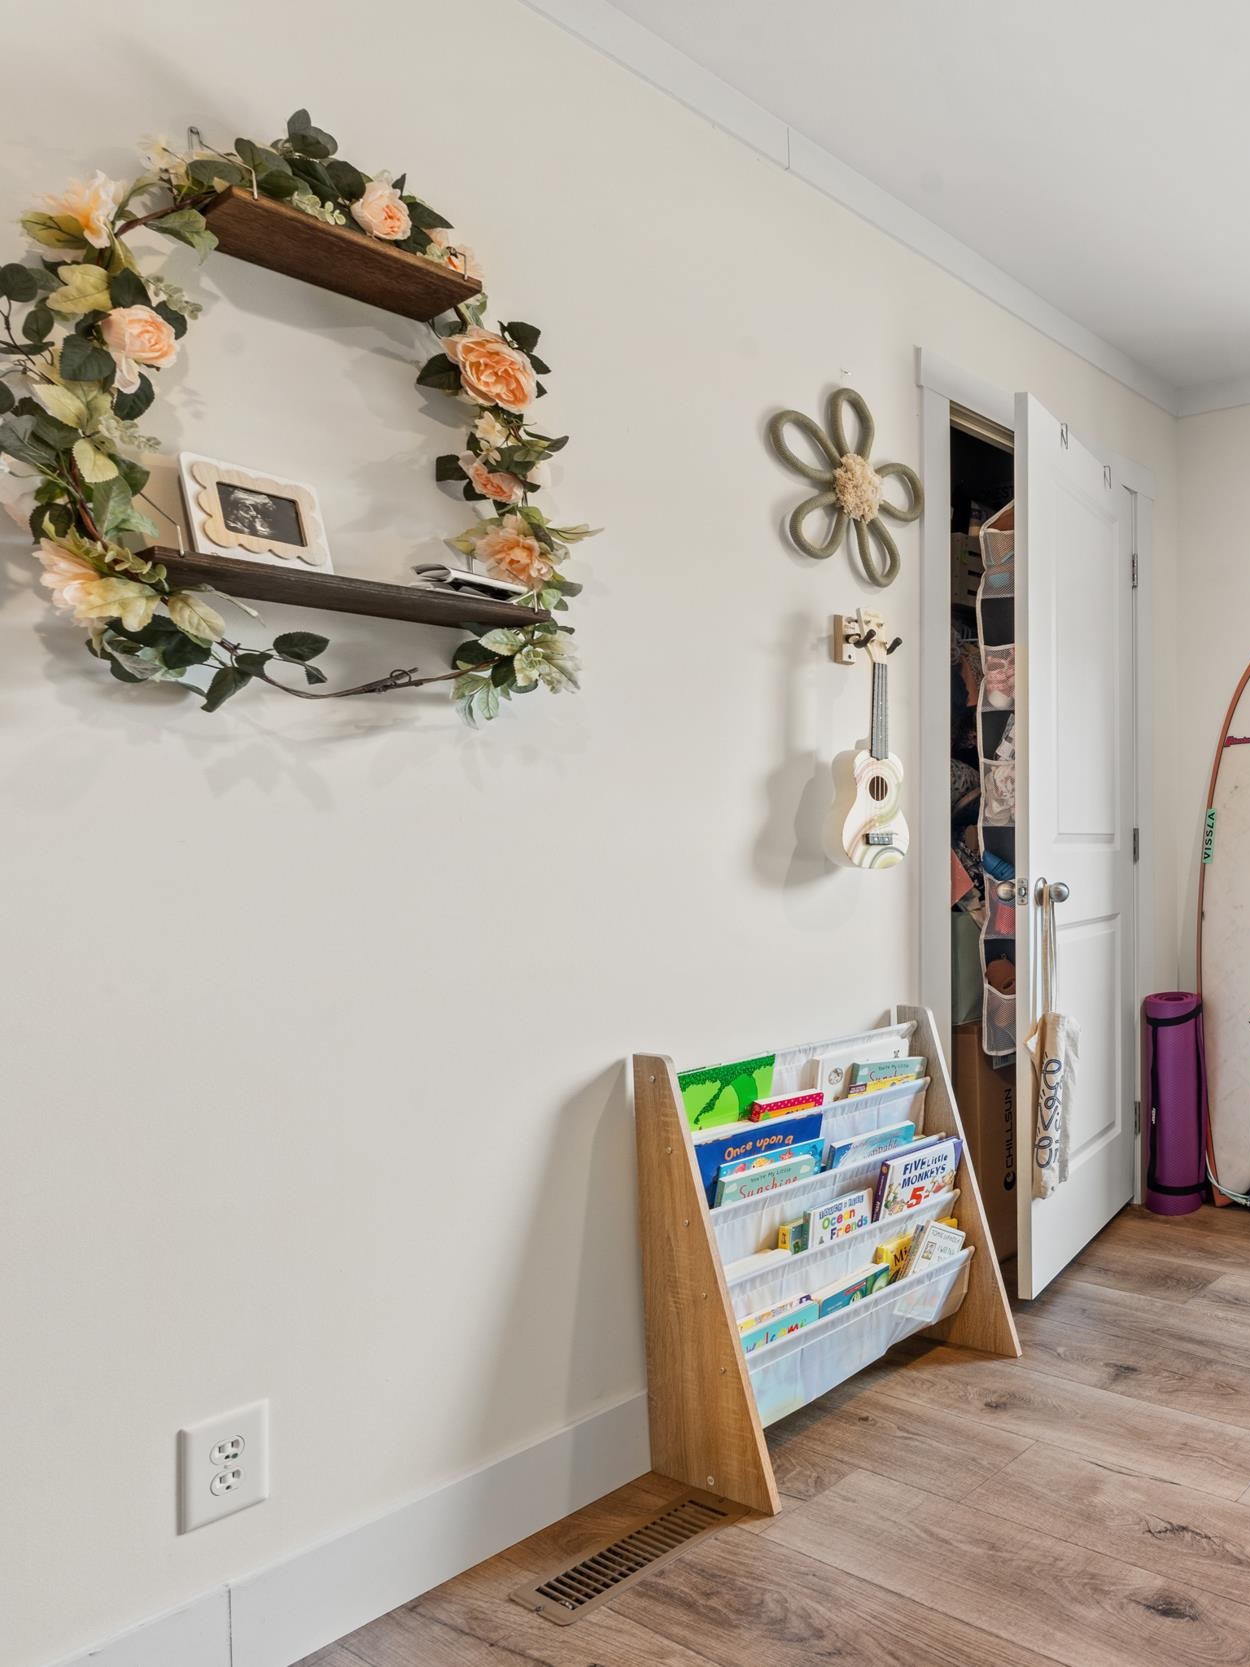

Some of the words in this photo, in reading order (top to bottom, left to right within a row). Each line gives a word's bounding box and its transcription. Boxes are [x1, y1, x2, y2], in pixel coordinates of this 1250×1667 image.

[1204, 811, 1215, 860] VISSLA
[724, 1140, 753, 1161] Once
[756, 1135, 782, 1151] upon
[784, 1135, 794, 1145] a
[901, 1164, 947, 1189] MONKEYS
[903, 1157, 926, 1176] FIVE
[927, 1153, 948, 1167] Little
[822, 1208, 856, 1230] Ocean
[830, 1216, 868, 1240] Friends
